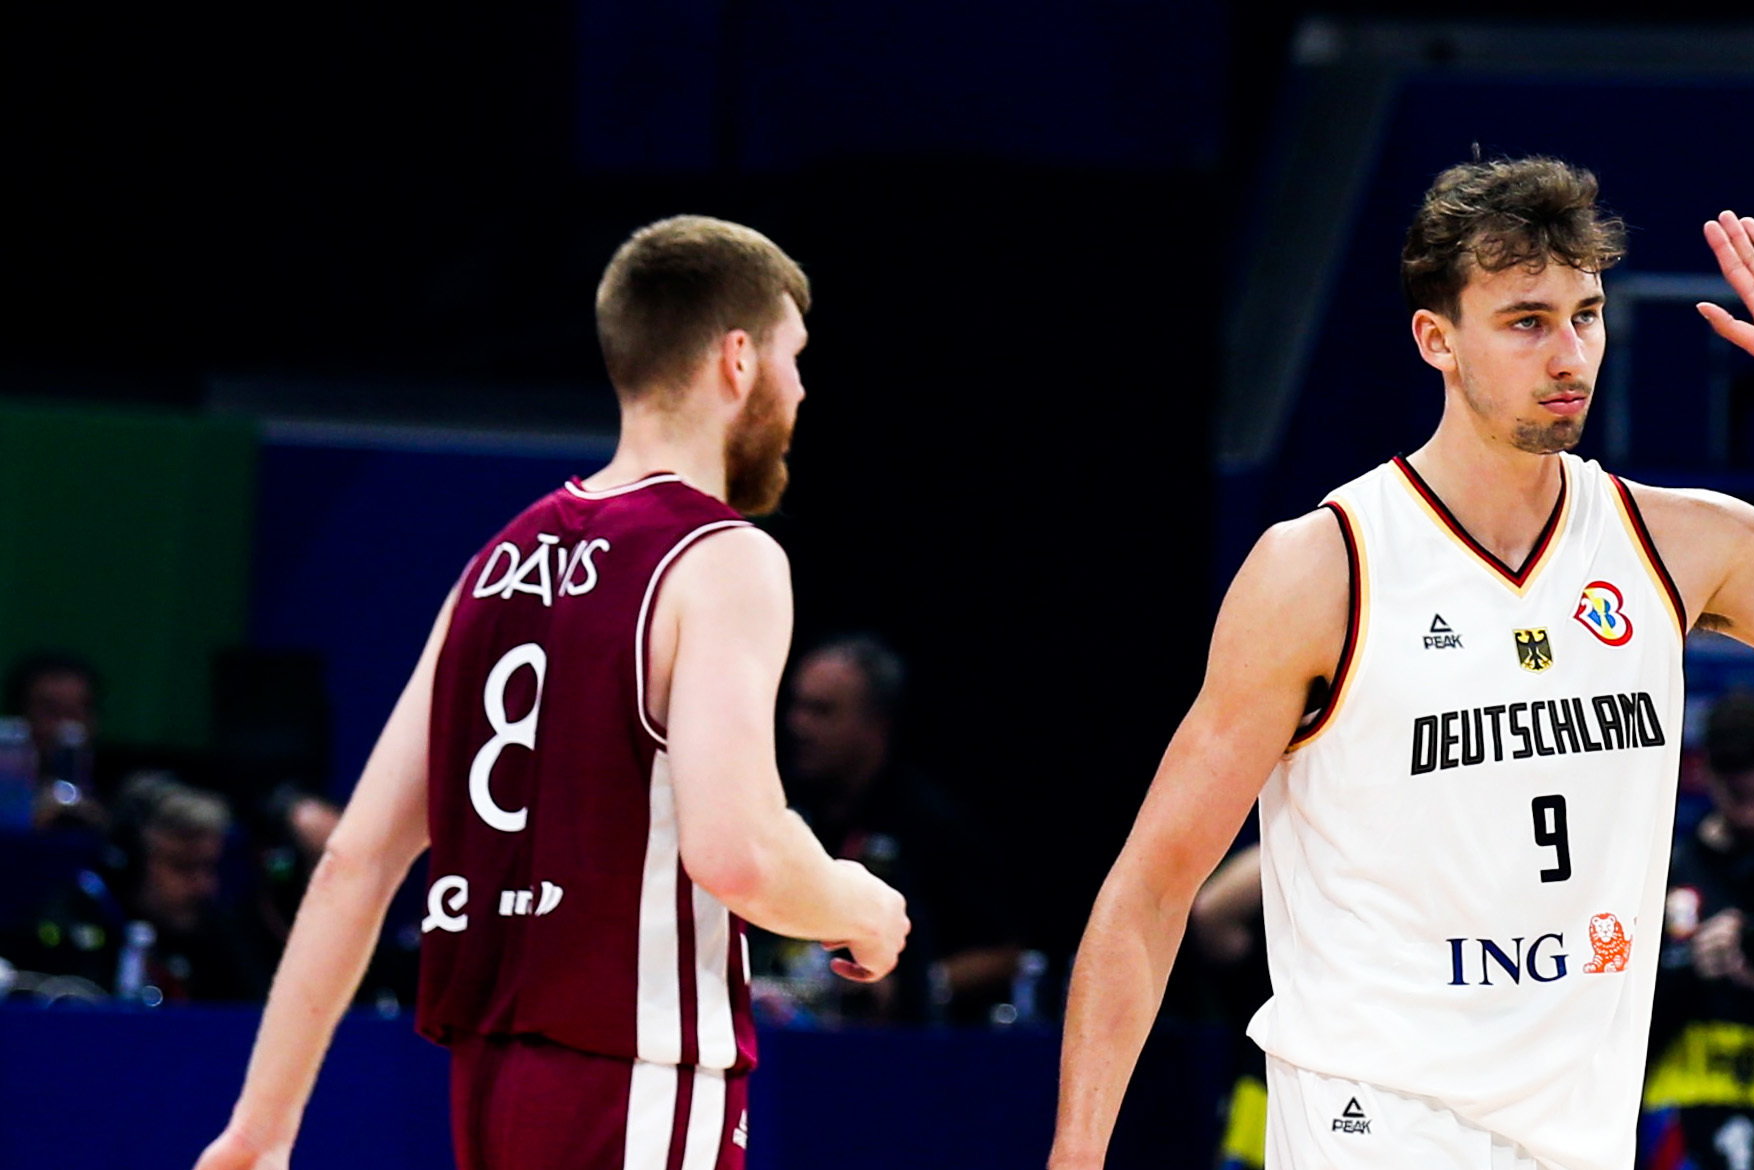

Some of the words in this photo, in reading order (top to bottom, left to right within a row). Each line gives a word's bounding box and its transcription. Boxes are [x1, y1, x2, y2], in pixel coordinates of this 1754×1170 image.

[1422, 634, 1465, 650] PEAK
[469, 643, 547, 832] 8
[1410, 691, 1667, 775] DEUTSCHLAND
[1531, 794, 1572, 883] 9
[1446, 933, 1570, 986] ING
[1331, 1118, 1372, 1135] PEAK
